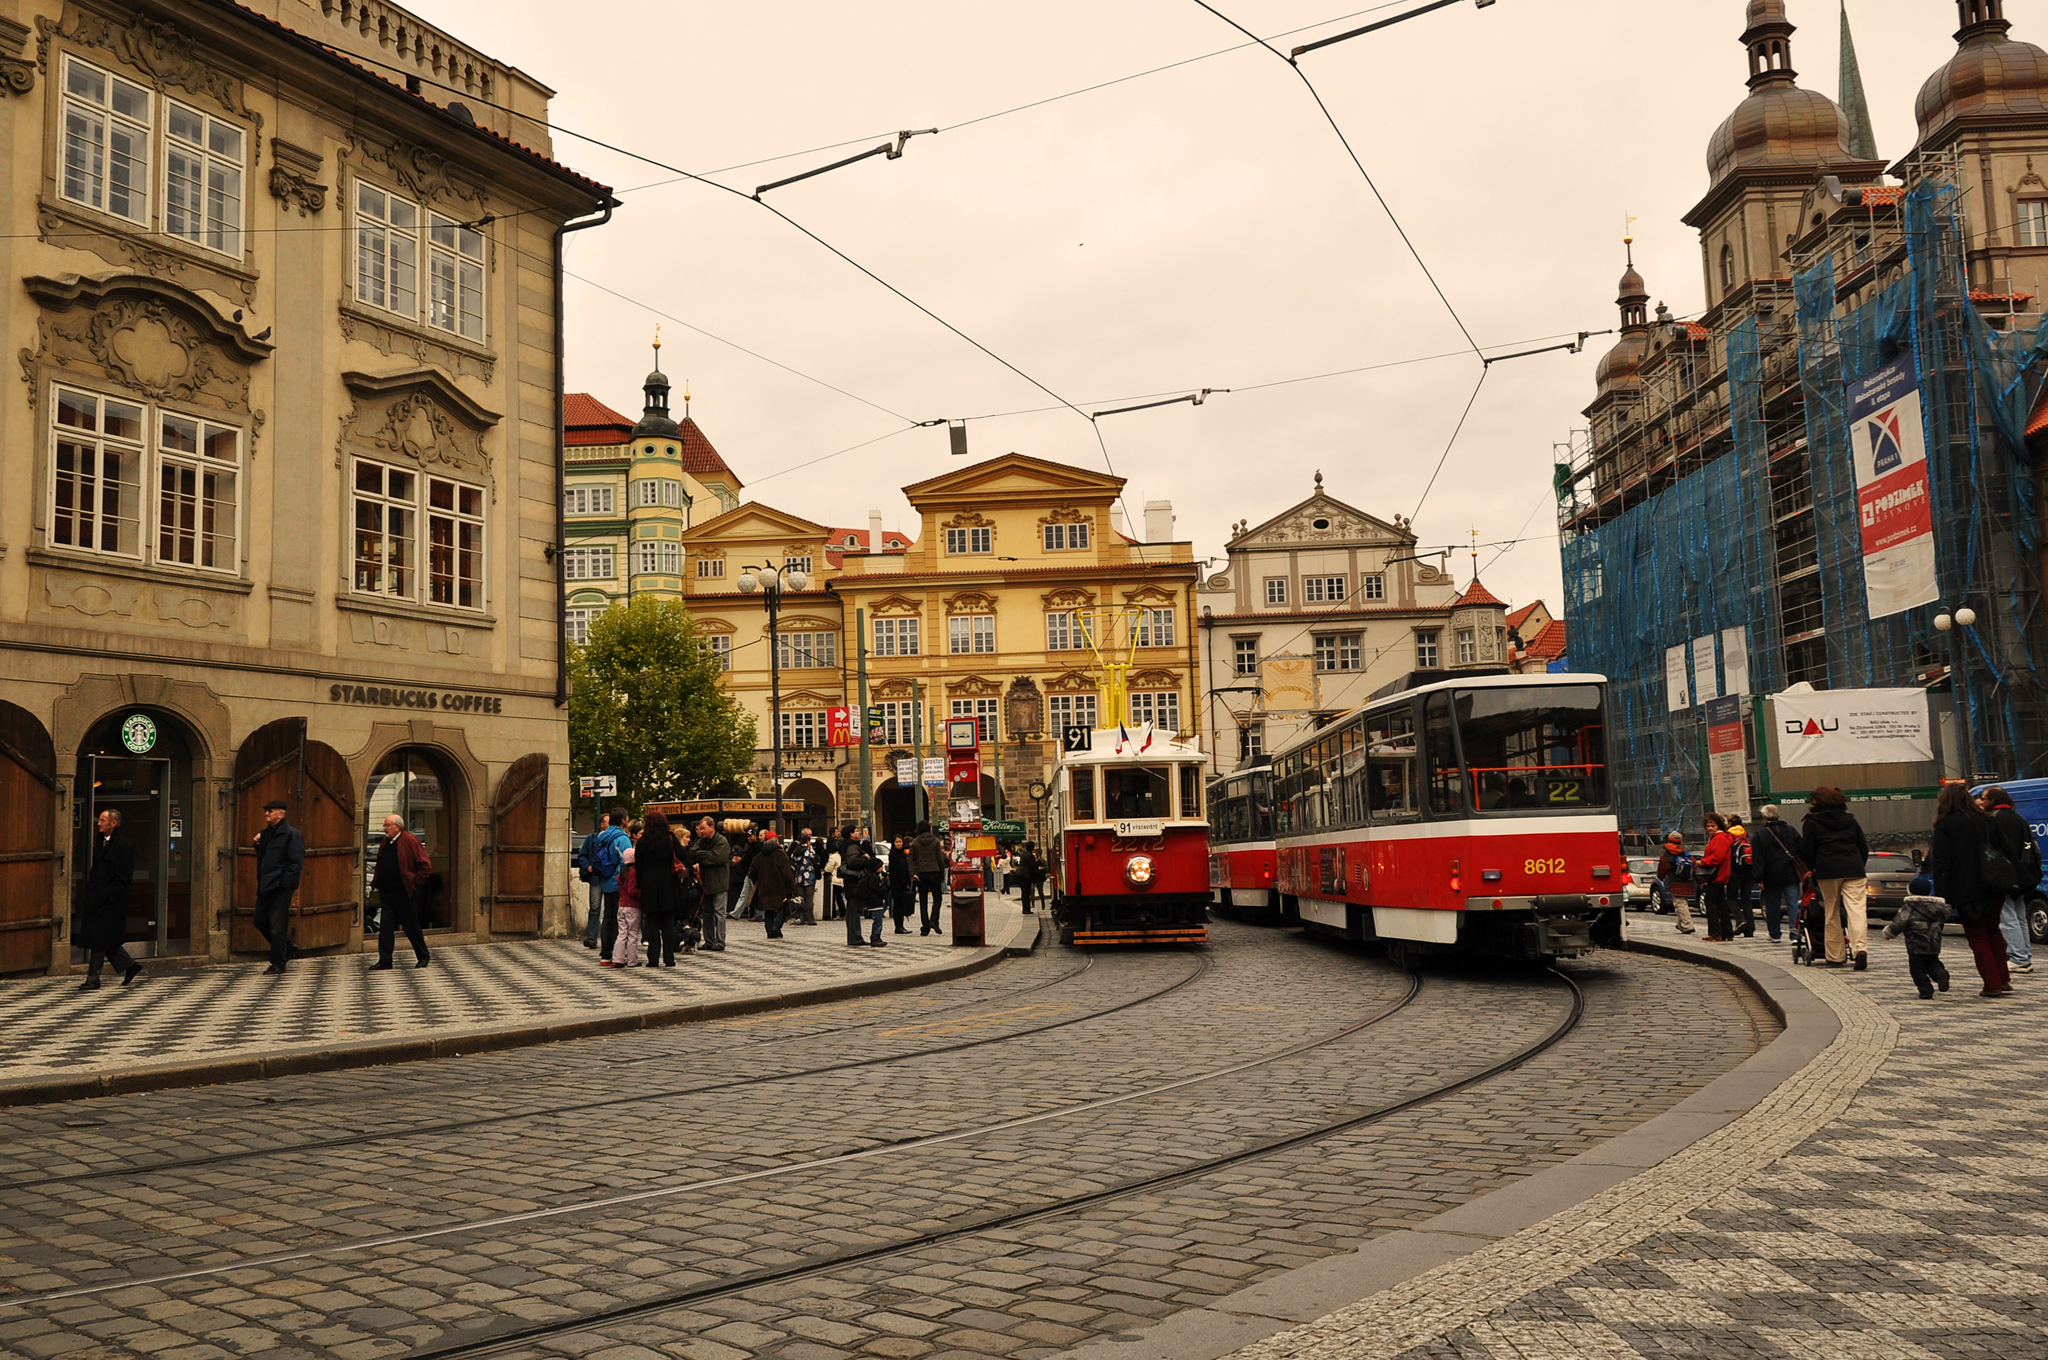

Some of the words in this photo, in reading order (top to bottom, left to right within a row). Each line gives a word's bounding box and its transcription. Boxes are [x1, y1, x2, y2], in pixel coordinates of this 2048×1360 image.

[1877, 454, 1895, 468] PRAHA
[1895, 452, 1898, 460] 1
[1875, 480, 1924, 514] PODZIMEK
[1875, 525, 1917, 546] www.podzimek.cz
[330, 684, 438, 709] STARBUCKS
[441, 693, 502, 714] COFFEE
[124, 716, 156, 733] STARBUCKS
[1785, 717, 1839, 735] BAU
[127, 741, 151, 751] COFFEE
[1069, 728, 1089, 749] 91
[1548, 782, 1580, 801] 22
[683, 800, 698, 811] Cold
[700, 799, 717, 810] drinks
[1120, 822, 1131, 833] 91
[1111, 836, 1165, 852] 2272
[1524, 858, 1565, 874] 8612
